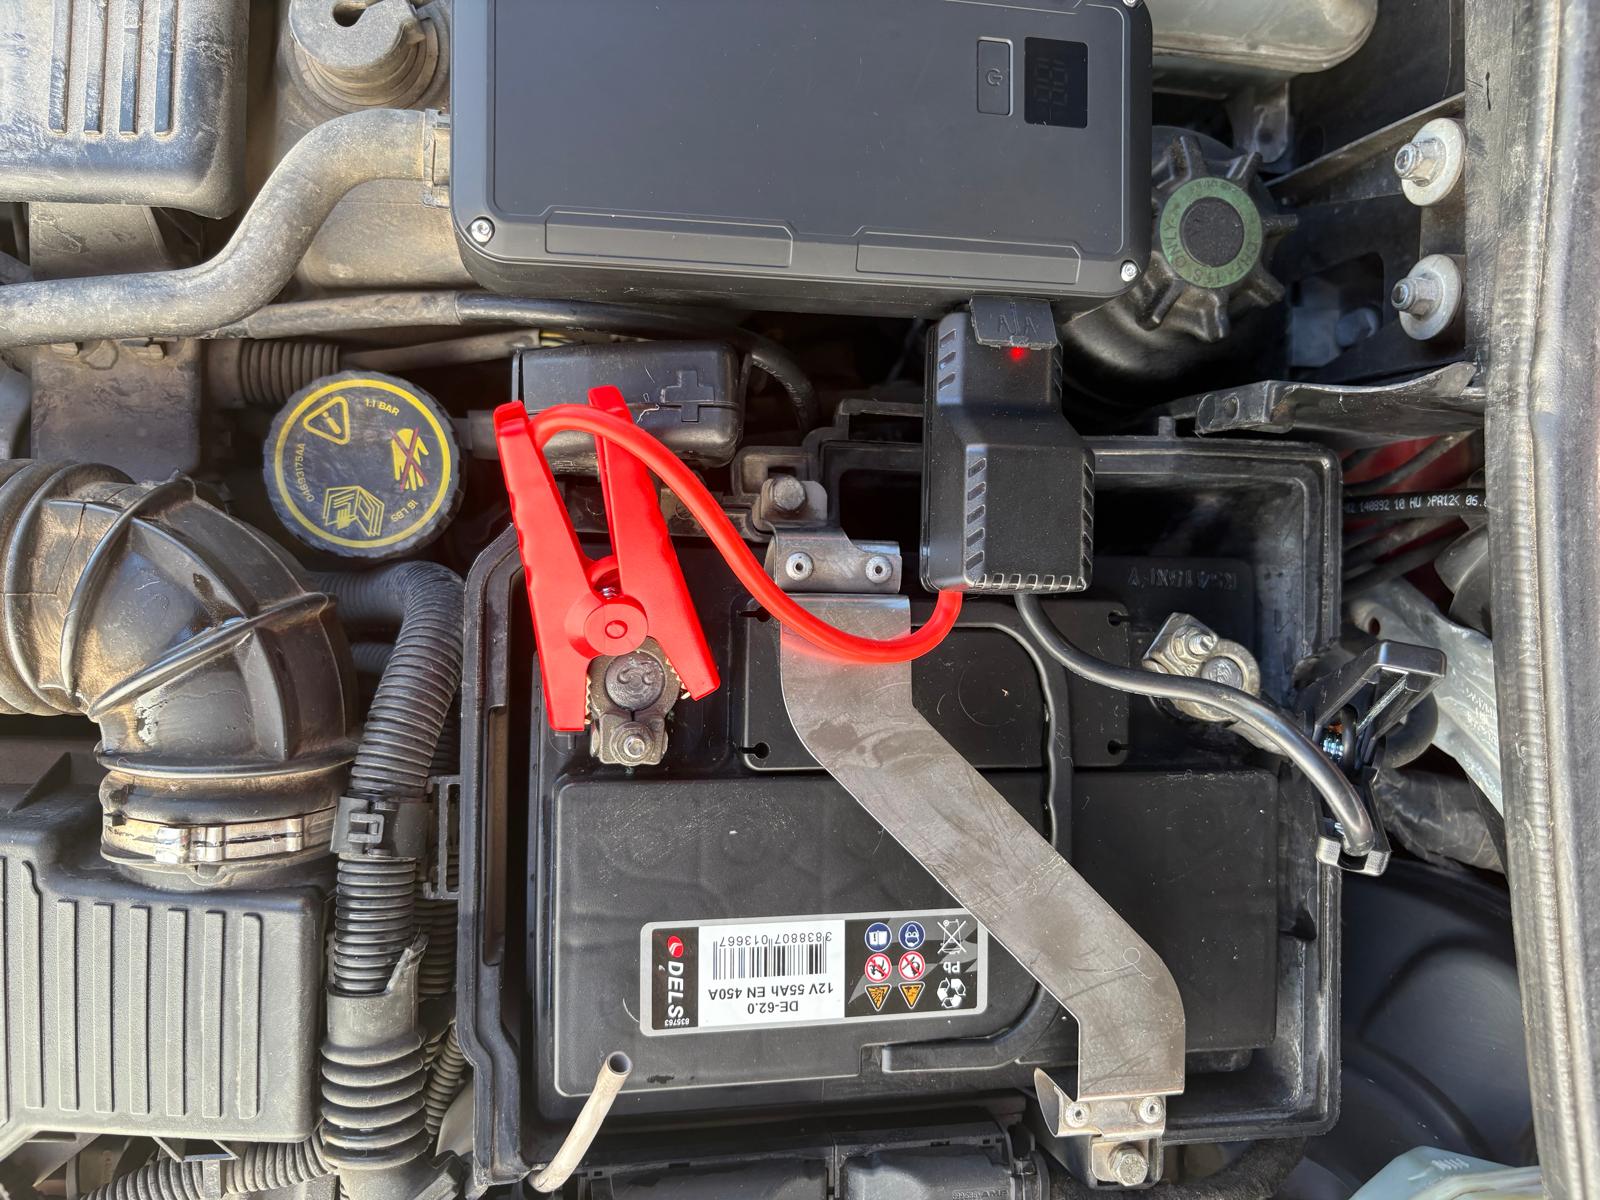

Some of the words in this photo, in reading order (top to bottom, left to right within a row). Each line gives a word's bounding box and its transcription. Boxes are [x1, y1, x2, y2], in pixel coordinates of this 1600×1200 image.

[378, 400, 400, 417] BAR
[390, 508, 409, 523] LBS
[943, 960, 960, 974] Pb
[708, 987, 743, 999] 450A
[747, 986, 766, 998] EN
[771, 985, 805, 999] 55Ah
[809, 983, 834, 997] 12V
[747, 1000, 799, 1015] DE-62.0
